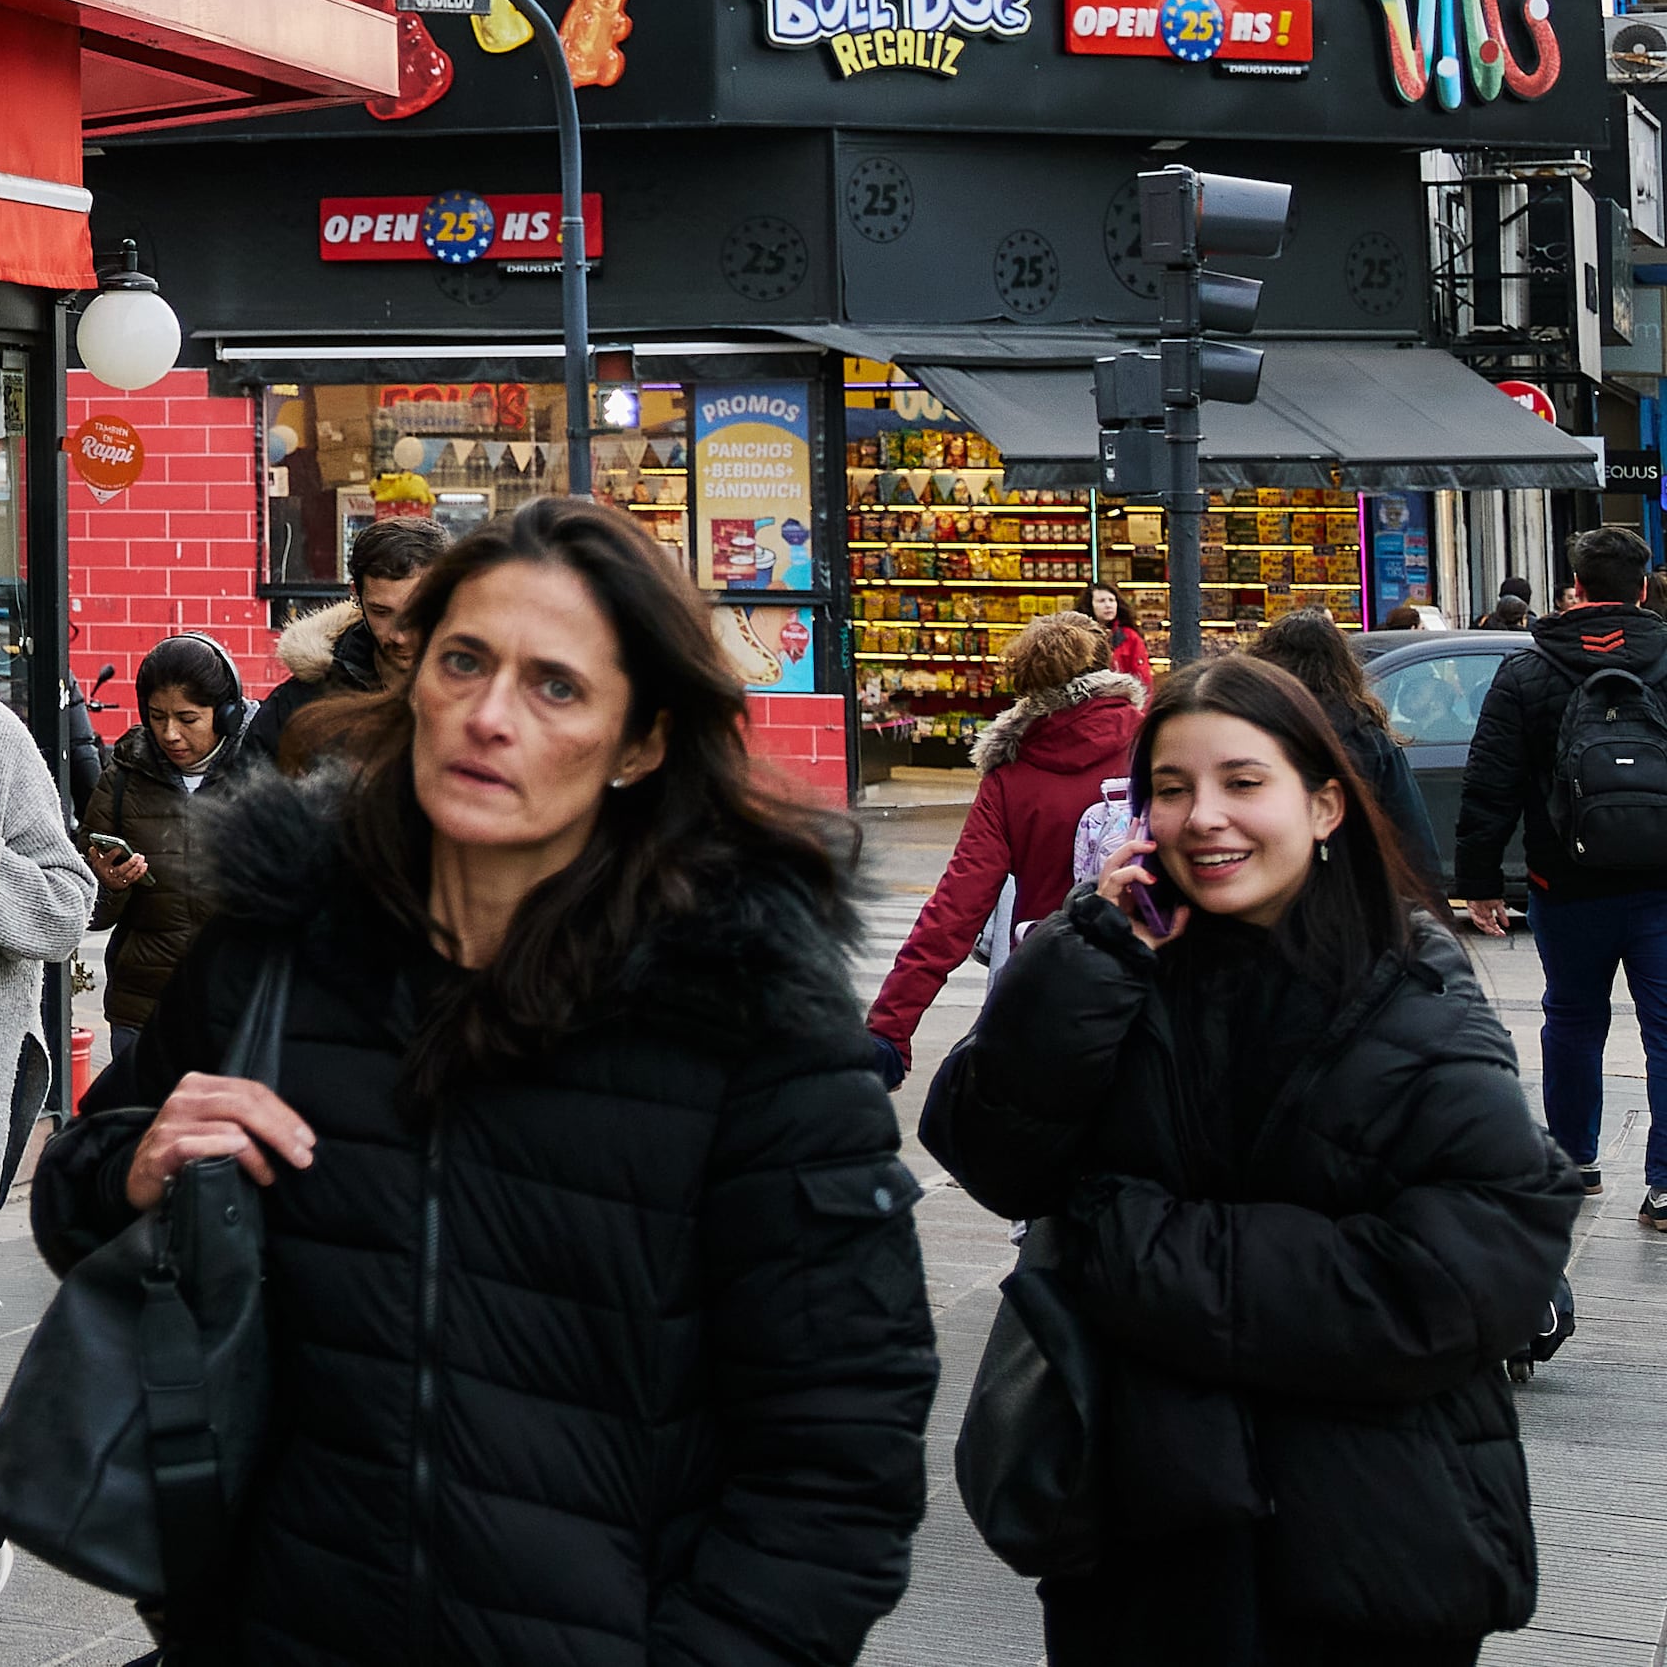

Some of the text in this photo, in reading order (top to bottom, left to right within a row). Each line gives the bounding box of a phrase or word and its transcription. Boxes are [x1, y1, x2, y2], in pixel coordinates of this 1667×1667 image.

[1073, 5, 1159, 38] OPEN
[1178, 10, 1215, 42] 25
[1228, 64, 1303, 76] DRUGSTORES
[865, 183, 898, 218] 25
[323, 213, 420, 244] OPEN
[435, 211, 480, 243] 25
[1008, 254, 1045, 290] 25
[701, 394, 801, 425] PROMOS
[80, 435, 136, 466] Rappi
[102, 434, 114, 444] EN
[706, 442, 794, 460] PANCHOS
[703, 478, 803, 499] SÁNDWICH
